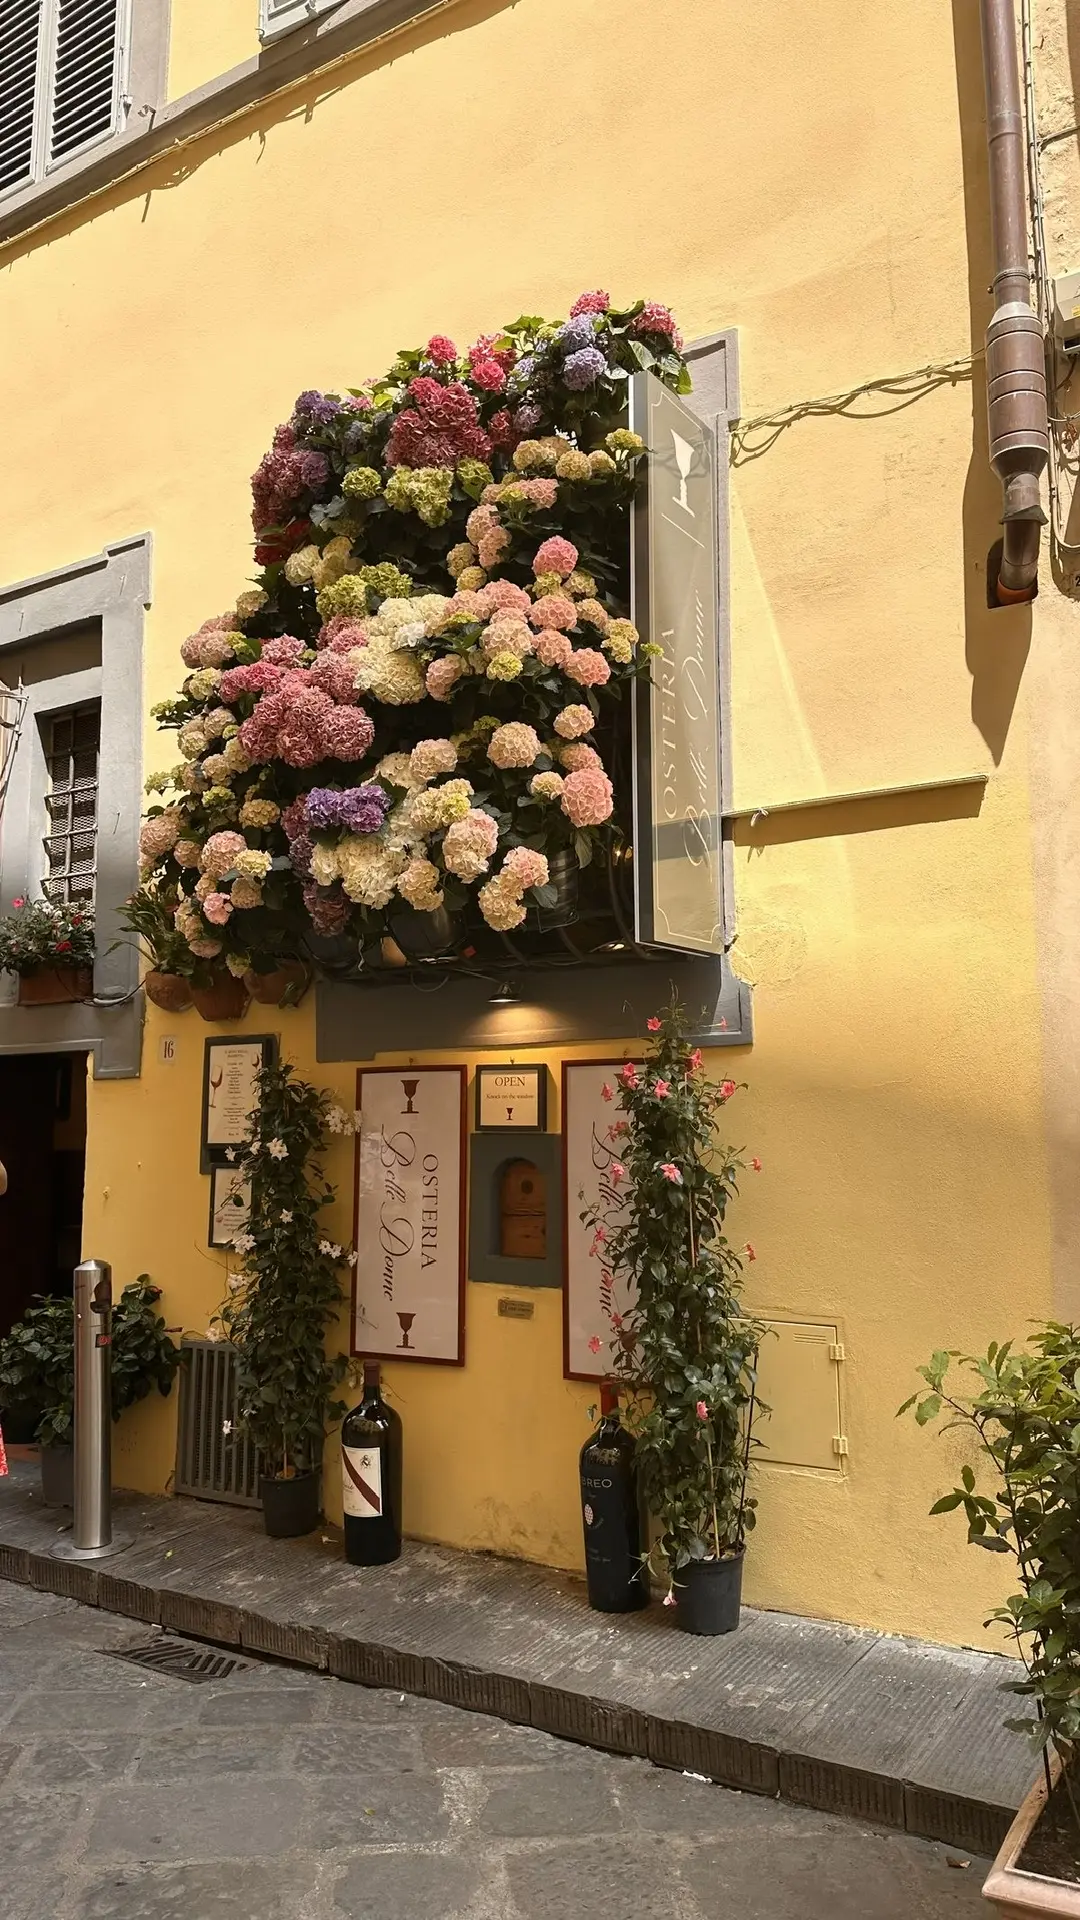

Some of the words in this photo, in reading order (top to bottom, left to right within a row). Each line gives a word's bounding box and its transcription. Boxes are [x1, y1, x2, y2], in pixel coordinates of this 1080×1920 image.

[681, 590, 709, 722] Donne
[662, 628, 678, 820] OSTERIA
[683, 743, 713, 883] Belle
[163, 1040, 174, 1059] 16
[494, 1076, 525, 1087] OPEN
[379, 1123, 417, 1204] Belle
[421, 1153, 439, 1271] OSTERIA
[378, 1201, 415, 1302] Donne
